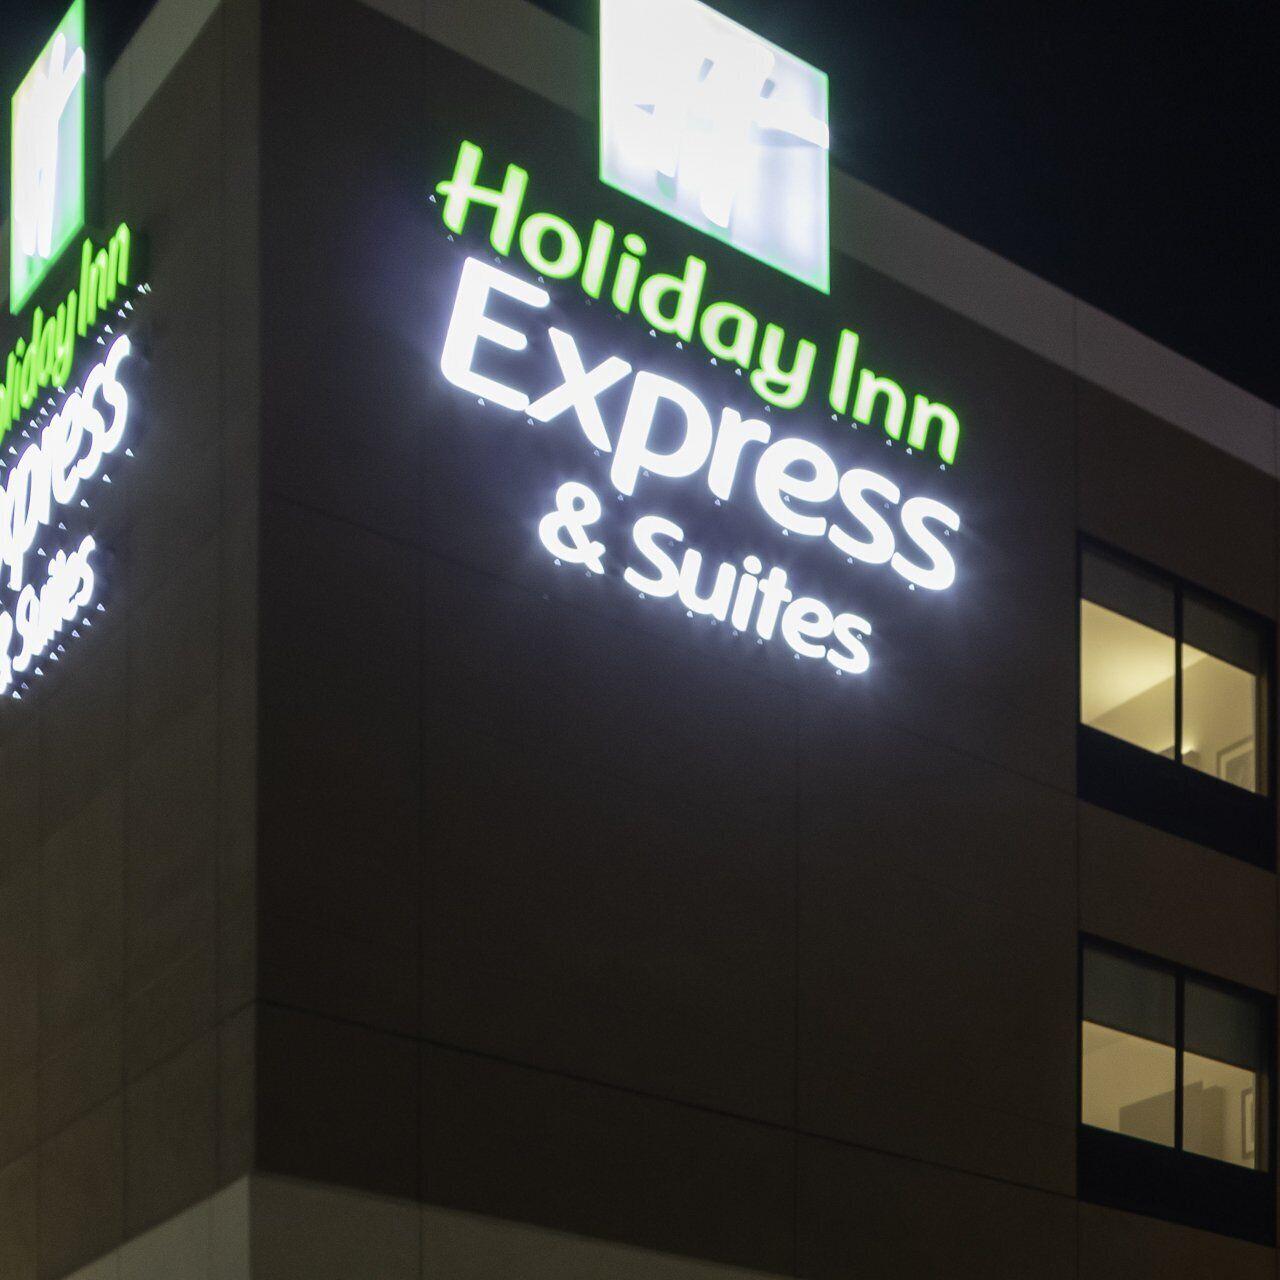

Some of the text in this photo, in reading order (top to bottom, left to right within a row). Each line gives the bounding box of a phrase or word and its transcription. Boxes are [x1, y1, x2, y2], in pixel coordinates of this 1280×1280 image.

[77, 222, 130, 338] Inn
[436, 140, 961, 465] Holiday Inn
[440, 256, 961, 591] Express
[538, 481, 872, 675] & Suites
